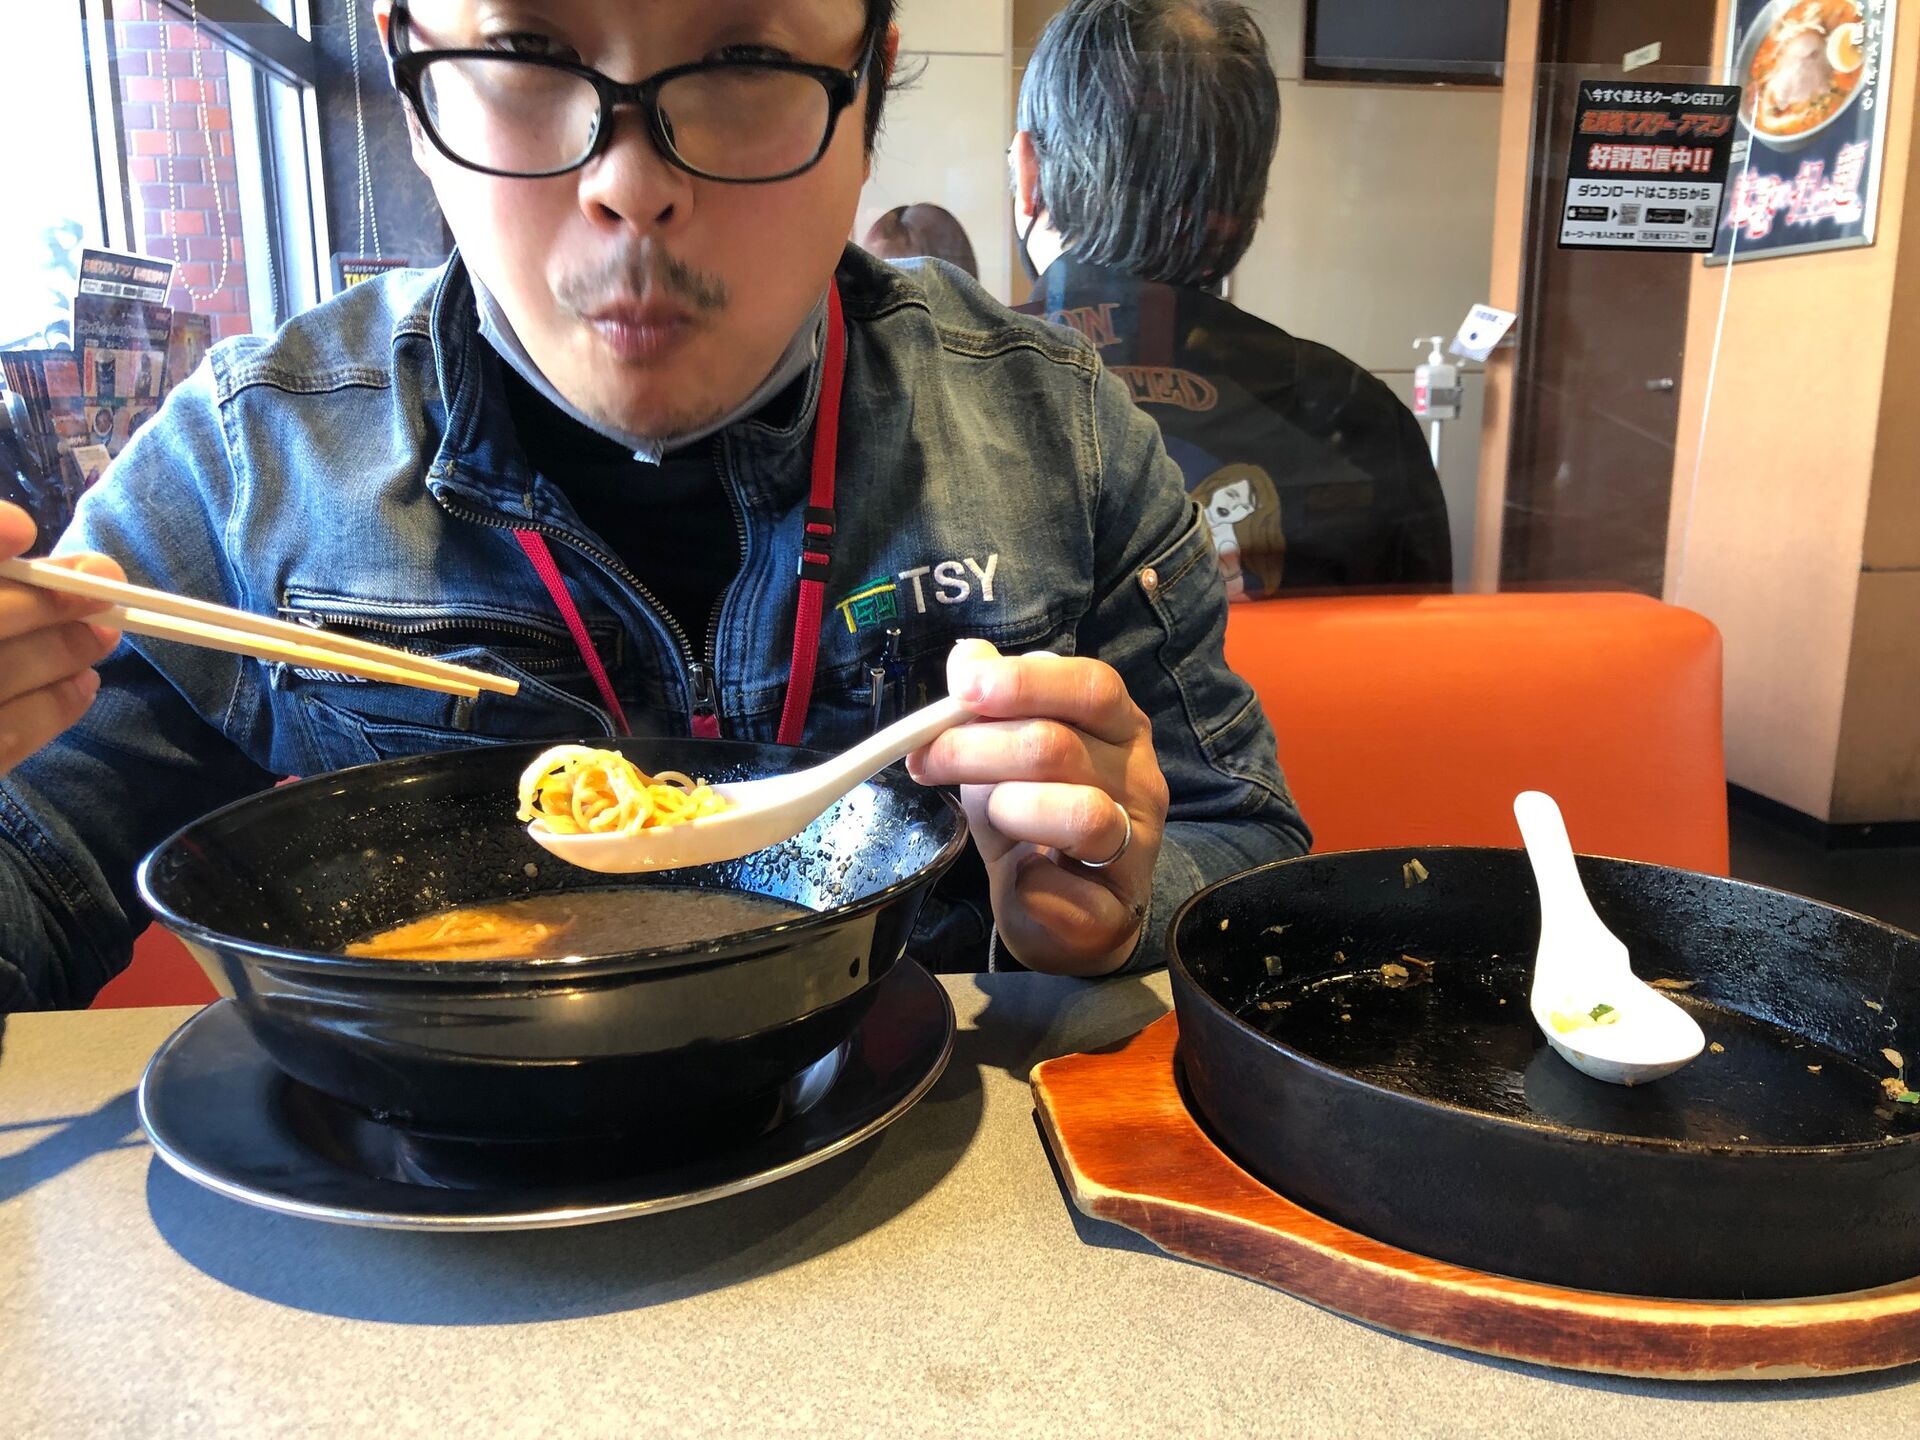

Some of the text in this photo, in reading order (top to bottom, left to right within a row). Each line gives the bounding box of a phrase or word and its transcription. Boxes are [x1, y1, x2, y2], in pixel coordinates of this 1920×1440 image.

[1577, 184, 1710, 200] ダウンロードはこちらから
